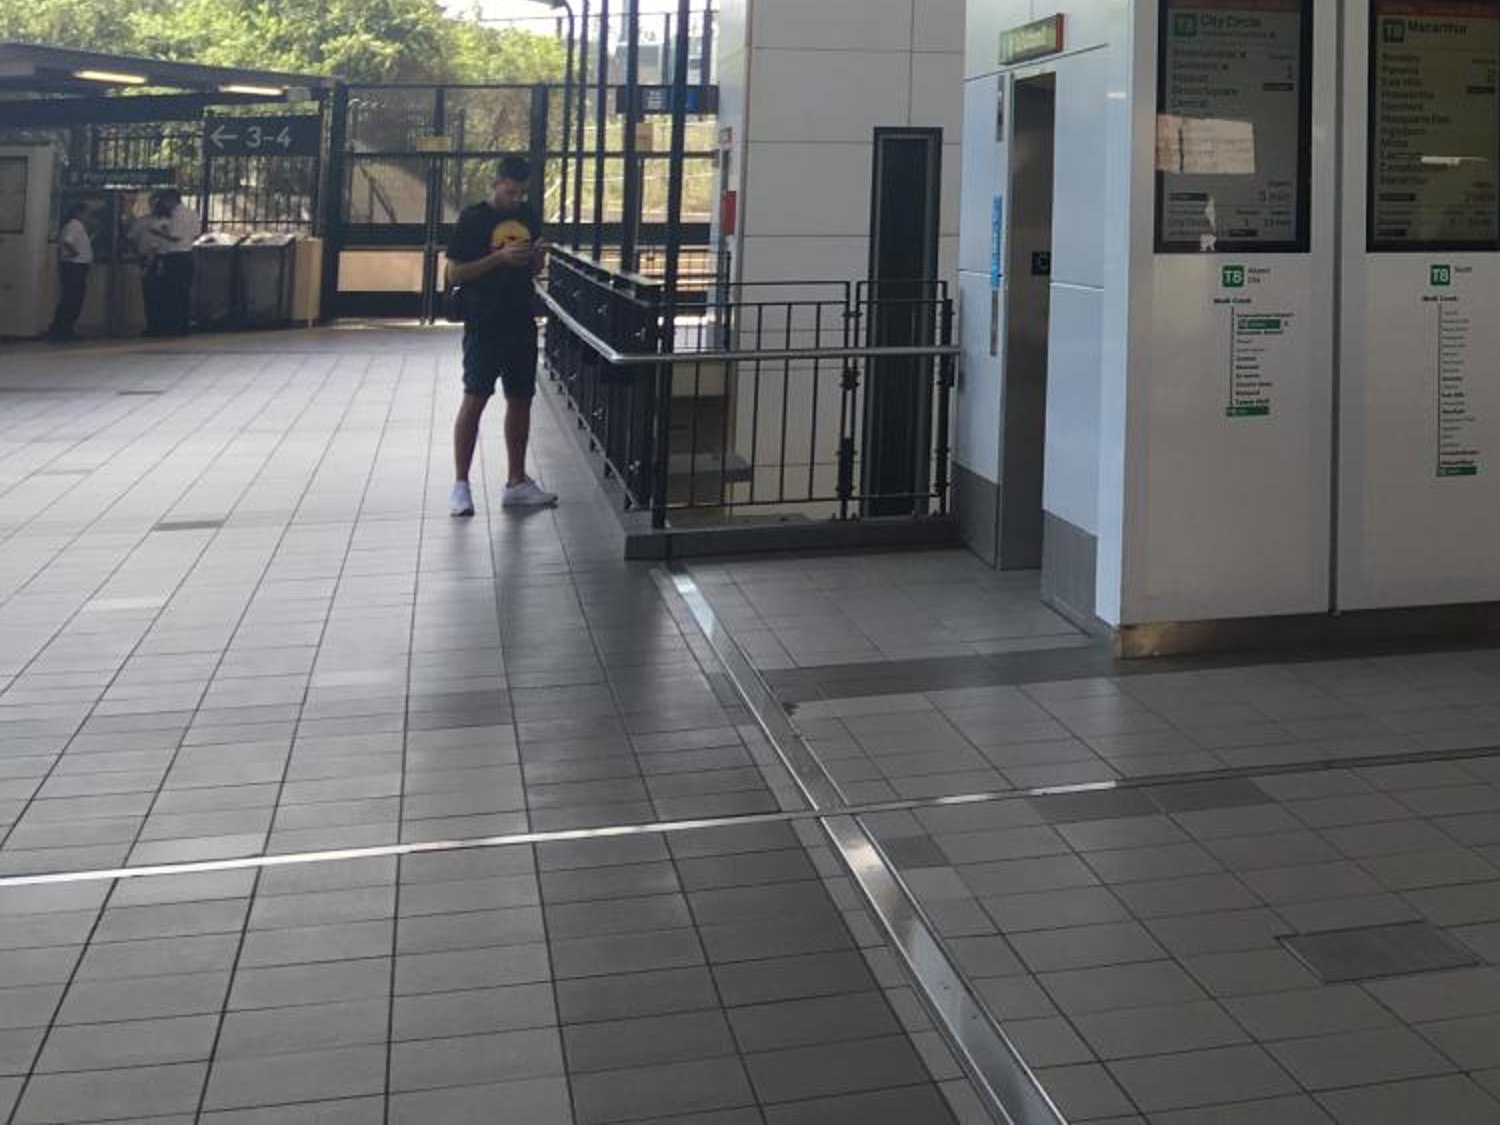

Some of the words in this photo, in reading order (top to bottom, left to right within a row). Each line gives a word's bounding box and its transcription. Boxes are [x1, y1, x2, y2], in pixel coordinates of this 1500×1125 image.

[246, 126, 292, 148] 3-4
[1223, 270, 1242, 284] T8
[1431, 269, 1449, 282] T8
